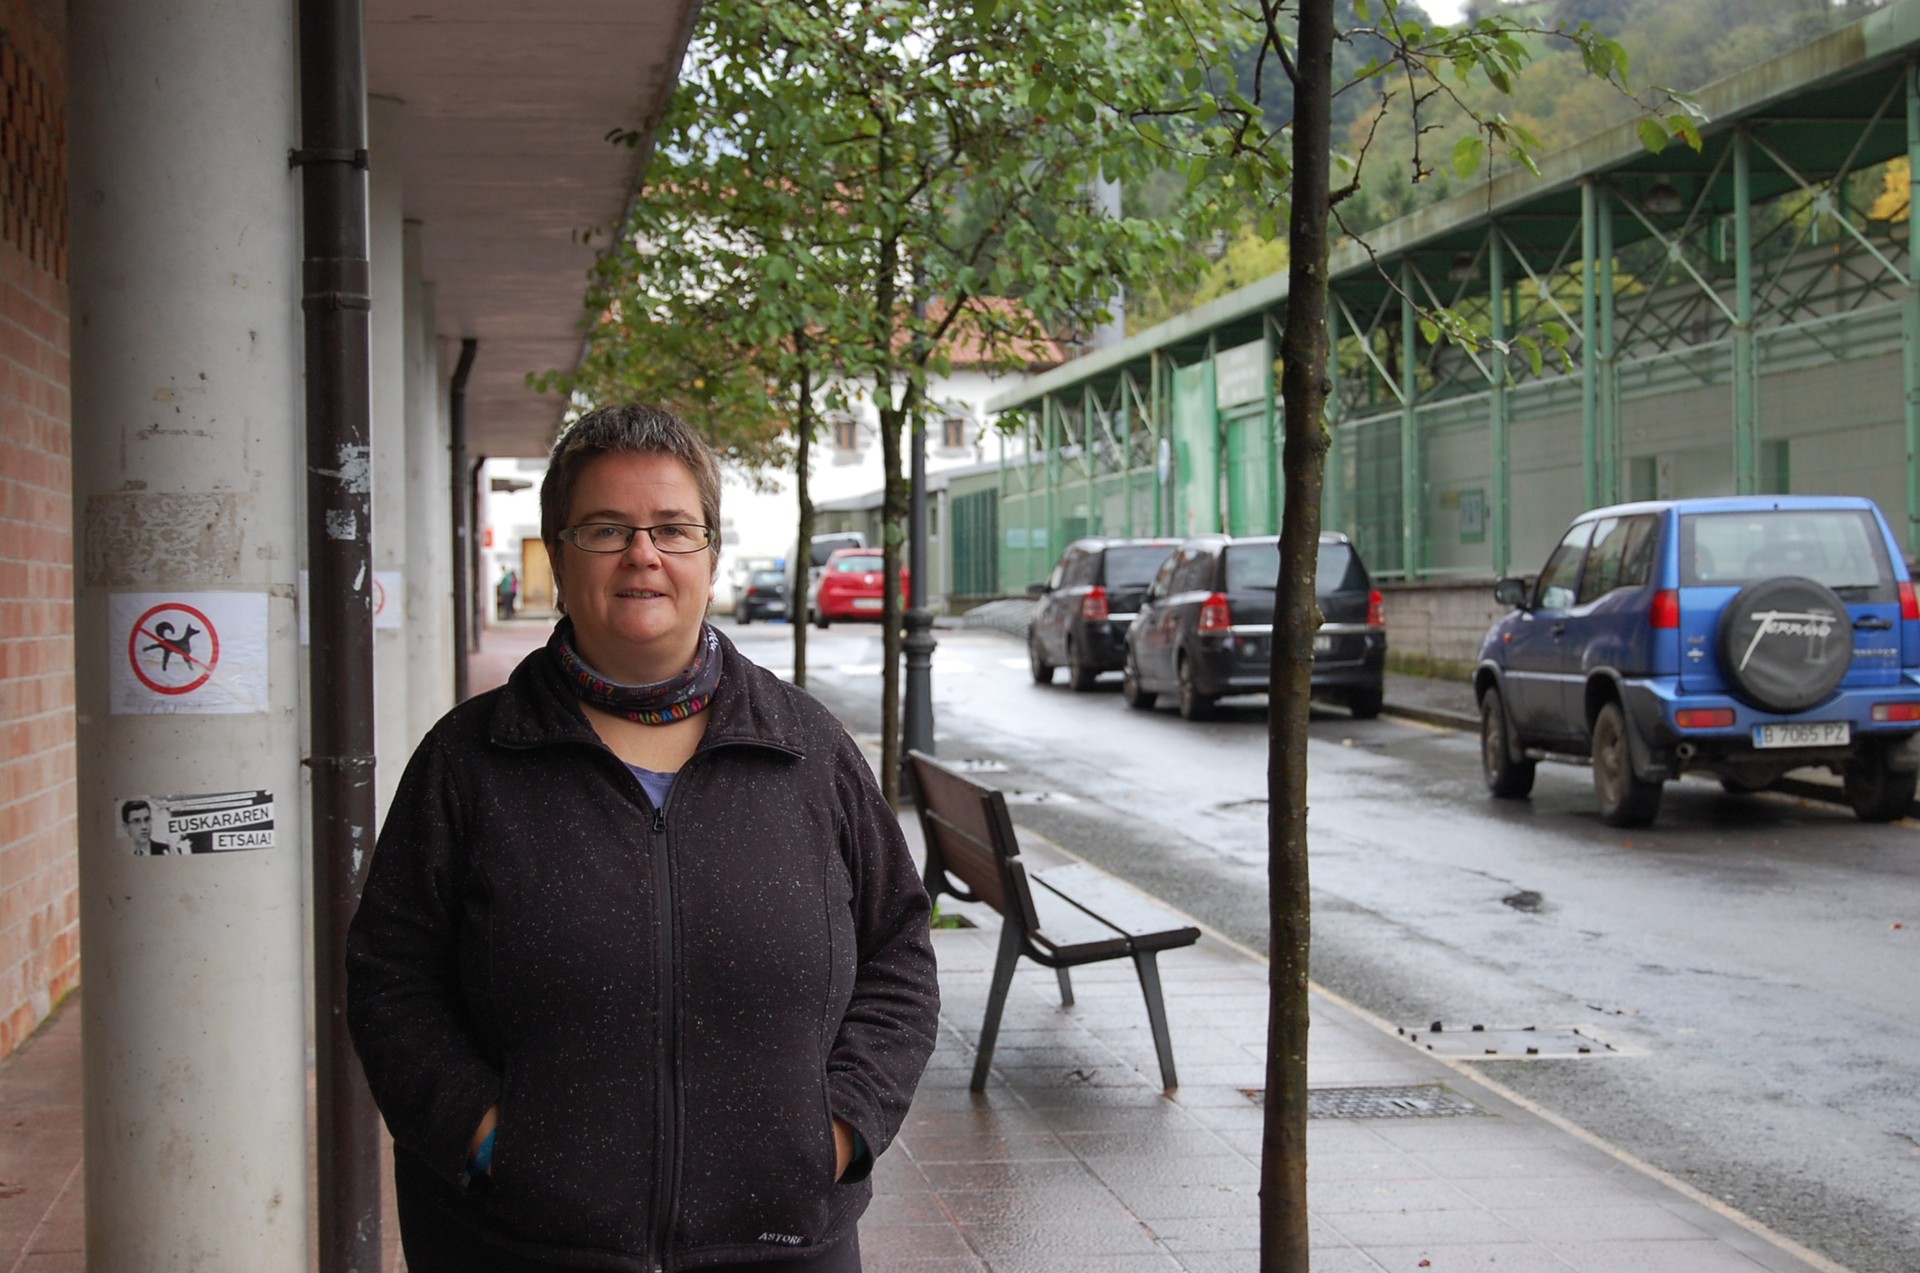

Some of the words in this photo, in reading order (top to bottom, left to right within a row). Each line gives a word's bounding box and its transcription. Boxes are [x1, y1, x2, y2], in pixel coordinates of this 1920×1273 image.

[1764, 726, 1774, 744] B
[1824, 723, 1845, 742] PZ
[168, 806, 269, 834] EUSKARAREN
[219, 833, 272, 847] ETSAIA!
